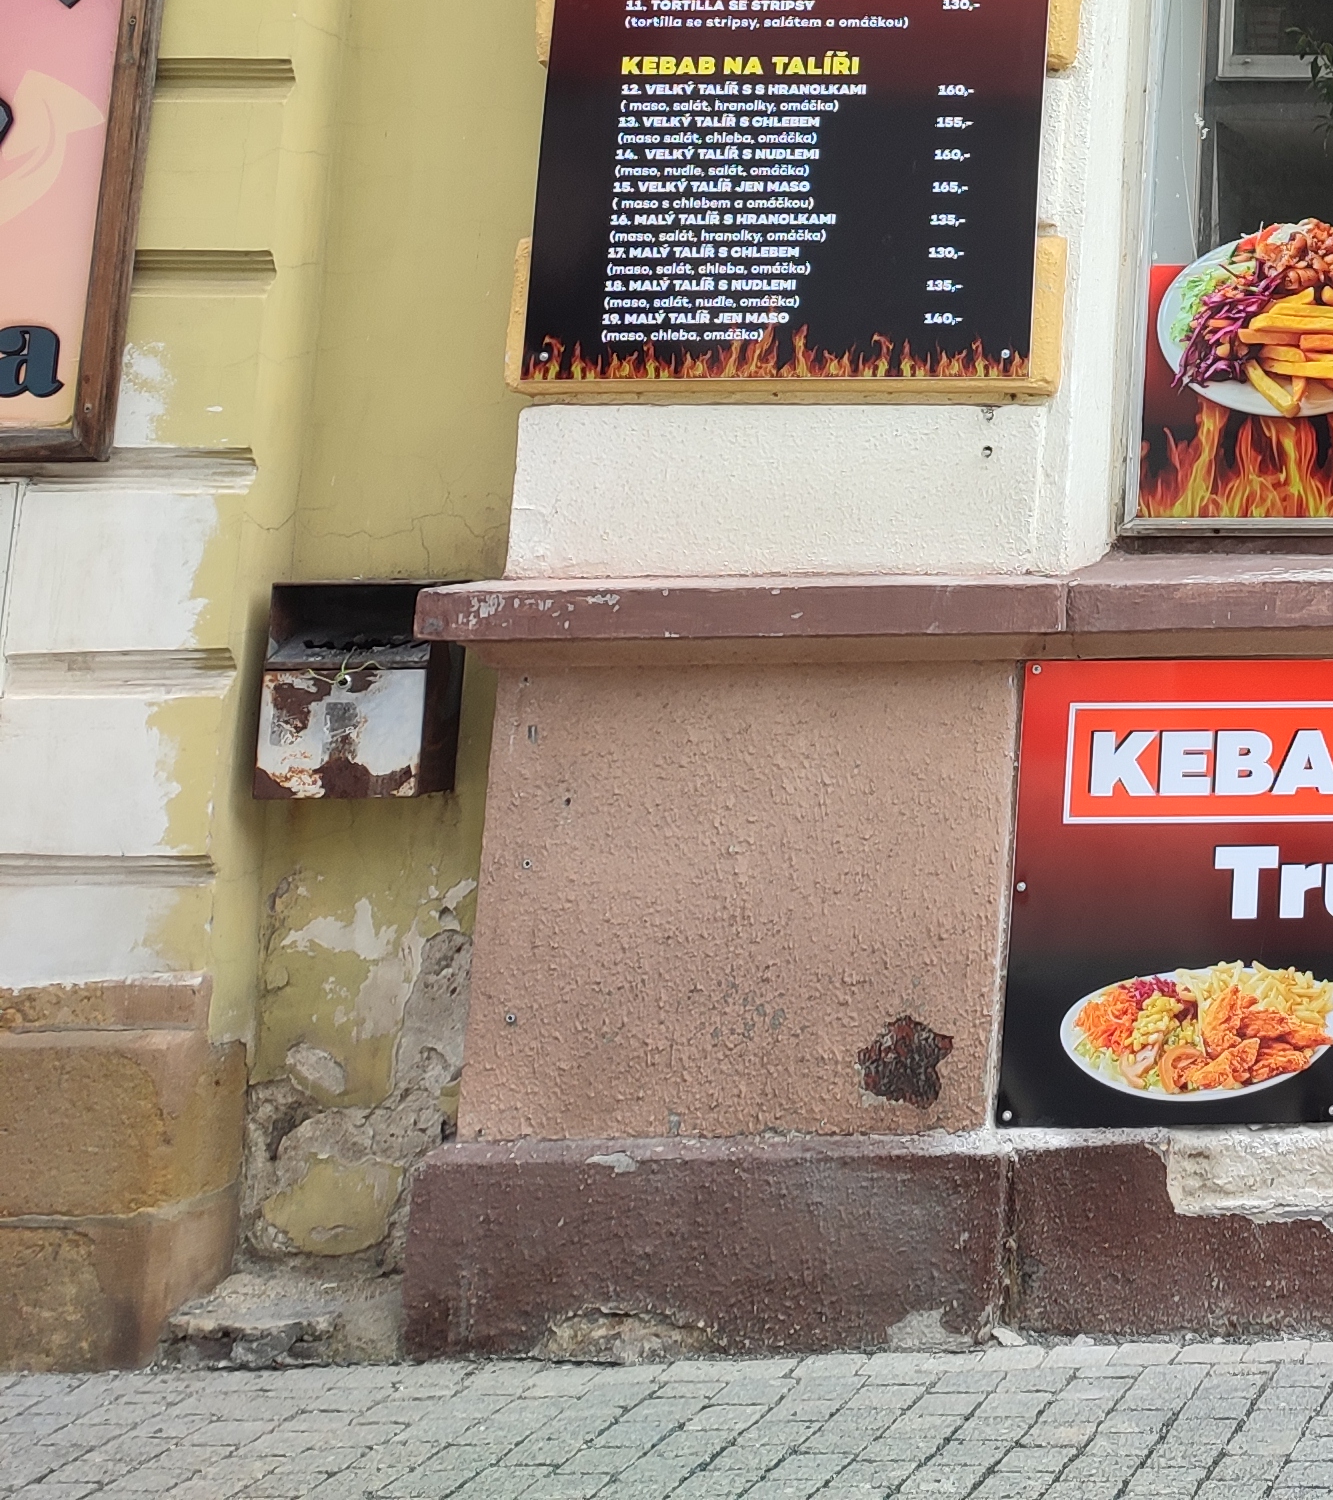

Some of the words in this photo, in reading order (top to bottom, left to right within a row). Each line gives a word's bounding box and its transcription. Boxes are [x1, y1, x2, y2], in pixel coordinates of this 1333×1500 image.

[625, 0, 648, 11] 11.
[650, 0, 725, 11] TORTILLA
[728, 0, 750, 10] SE
[750, 0, 816, 11] STRIPSY
[621, 57, 716, 75] KEBAB
[723, 57, 764, 74] NA
[771, 51, 860, 74] TALÍŘI
[612, 183, 635, 192] 15.
[637, 178, 689, 192] VELKÝ
[689, 178, 733, 192] TALÍŘ
[734, 181, 765, 192] JEN
[766, 181, 811, 192] MASO
[607, 248, 627, 258] 17.
[628, 244, 671, 258] MALÝ
[672, 244, 715, 258] TALÍŘ
[717, 247, 729, 257] S
[730, 246, 800, 257] CHLEBEM
